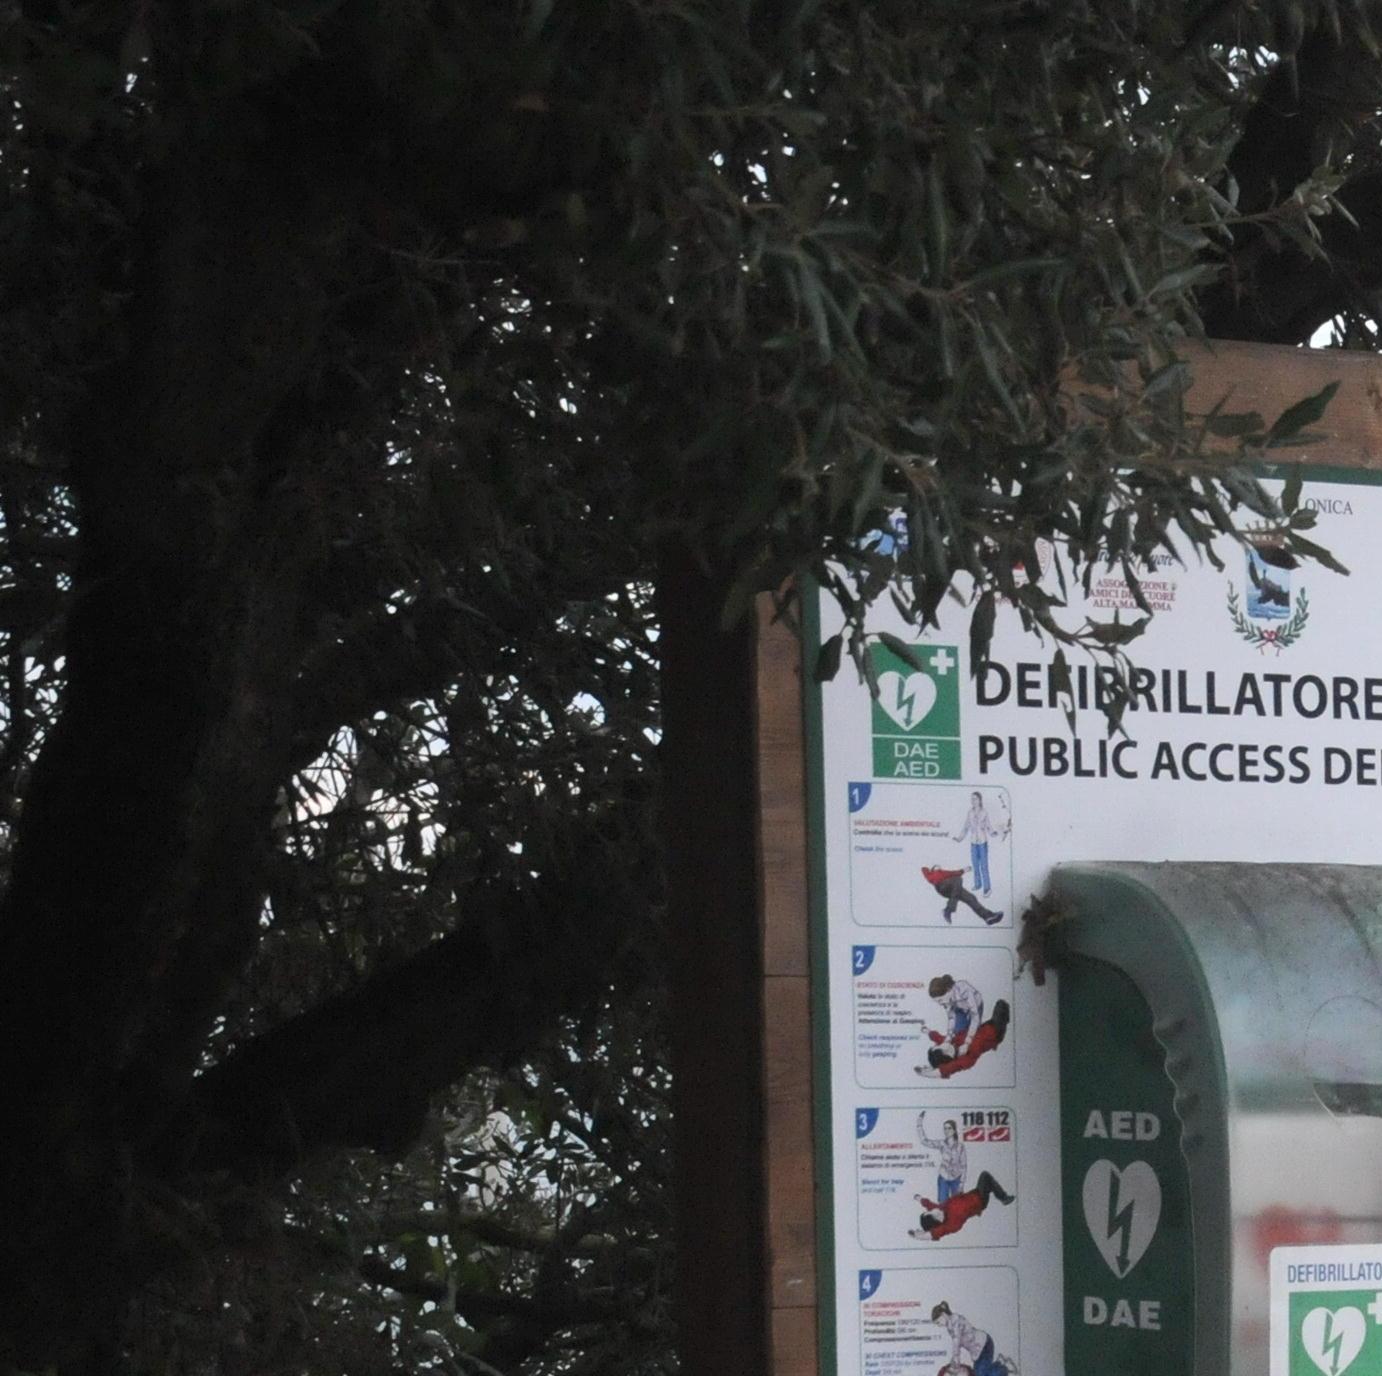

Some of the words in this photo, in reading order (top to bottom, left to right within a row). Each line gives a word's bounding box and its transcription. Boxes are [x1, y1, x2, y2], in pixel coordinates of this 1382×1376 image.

[1305, 498, 1353, 515] ONICA
[1097, 579, 1169, 591] ASSOCZIONE
[894, 742, 939, 759] DAE
[978, 735, 1138, 779] PUBLIC
[1150, 741, 1311, 785] ACCESS
[894, 761, 940, 777] AED
[852, 788, 859, 805] 1
[855, 951, 864, 968] 2
[859, 1113, 868, 1130] 3
[961, 1111, 984, 1126] 118
[987, 1111, 1009, 1126] 112
[1083, 1109, 1161, 1141] AED
[862, 1275, 871, 1292] 4
[1083, 1296, 1161, 1330] DAE
